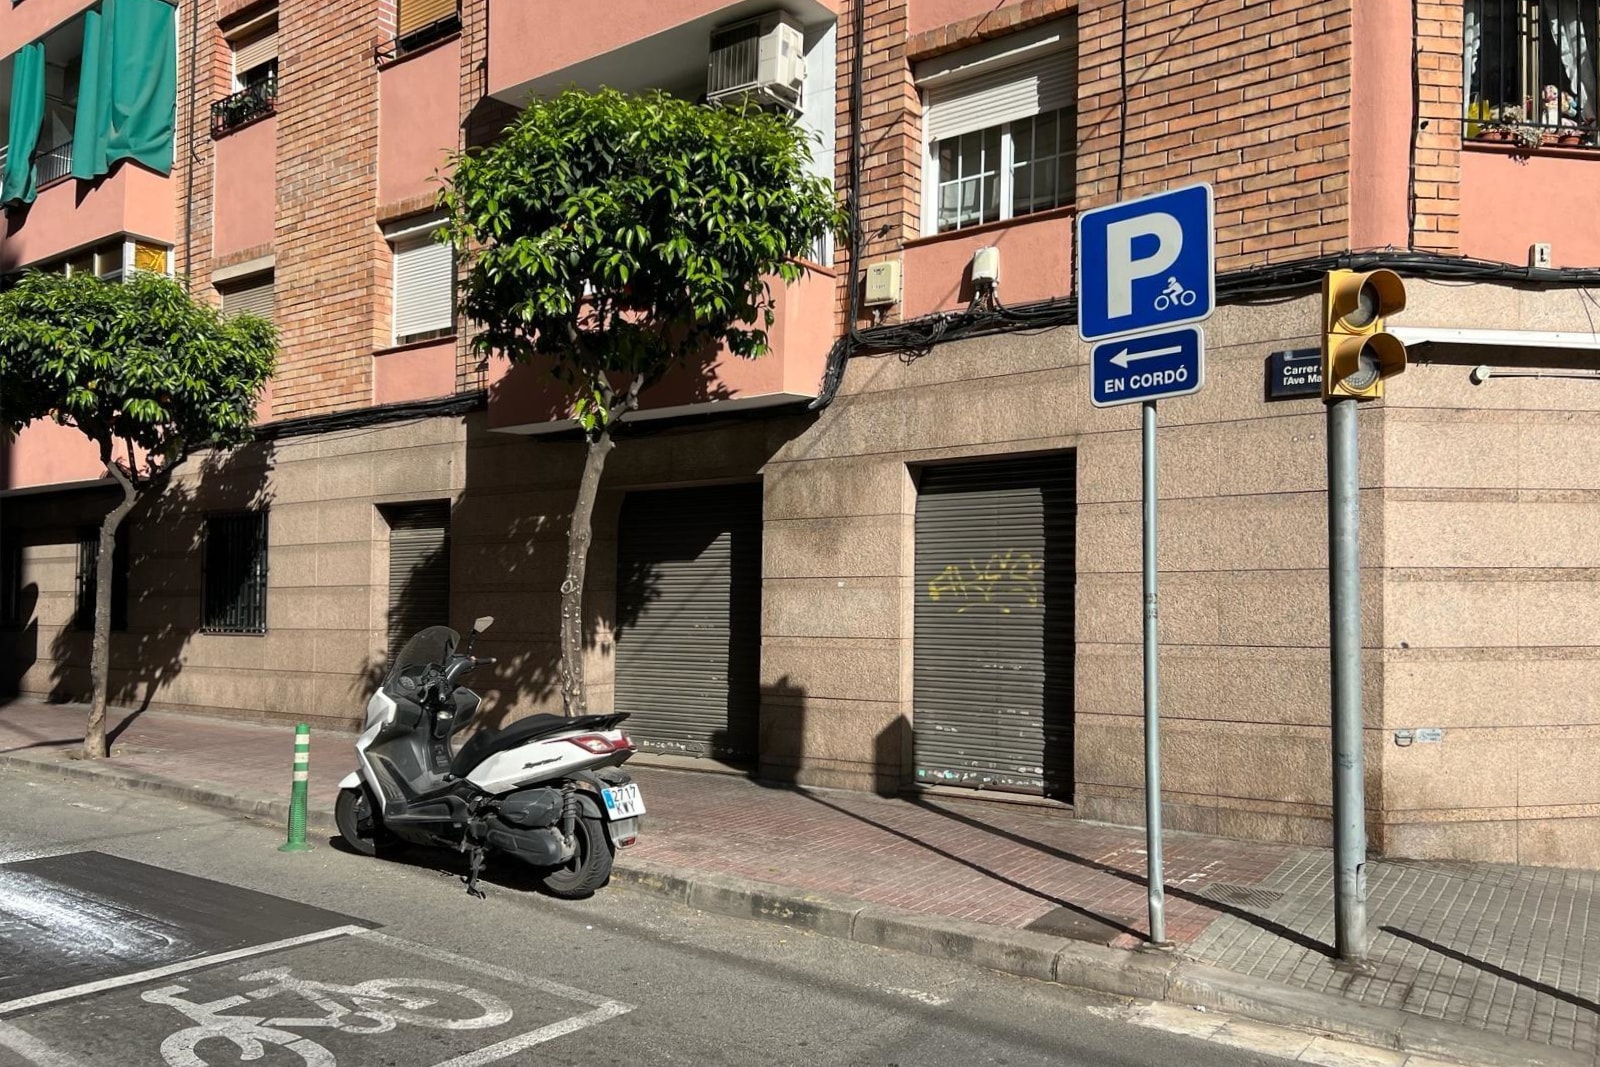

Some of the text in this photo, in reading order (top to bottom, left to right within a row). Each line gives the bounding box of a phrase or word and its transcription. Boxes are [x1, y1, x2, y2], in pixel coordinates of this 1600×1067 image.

[1107, 212, 1183, 319] P
[1104, 365, 1188, 394] EN CORDÓ
[1283, 365, 1318, 375] Carrer
[611, 785, 636, 802] 2717
